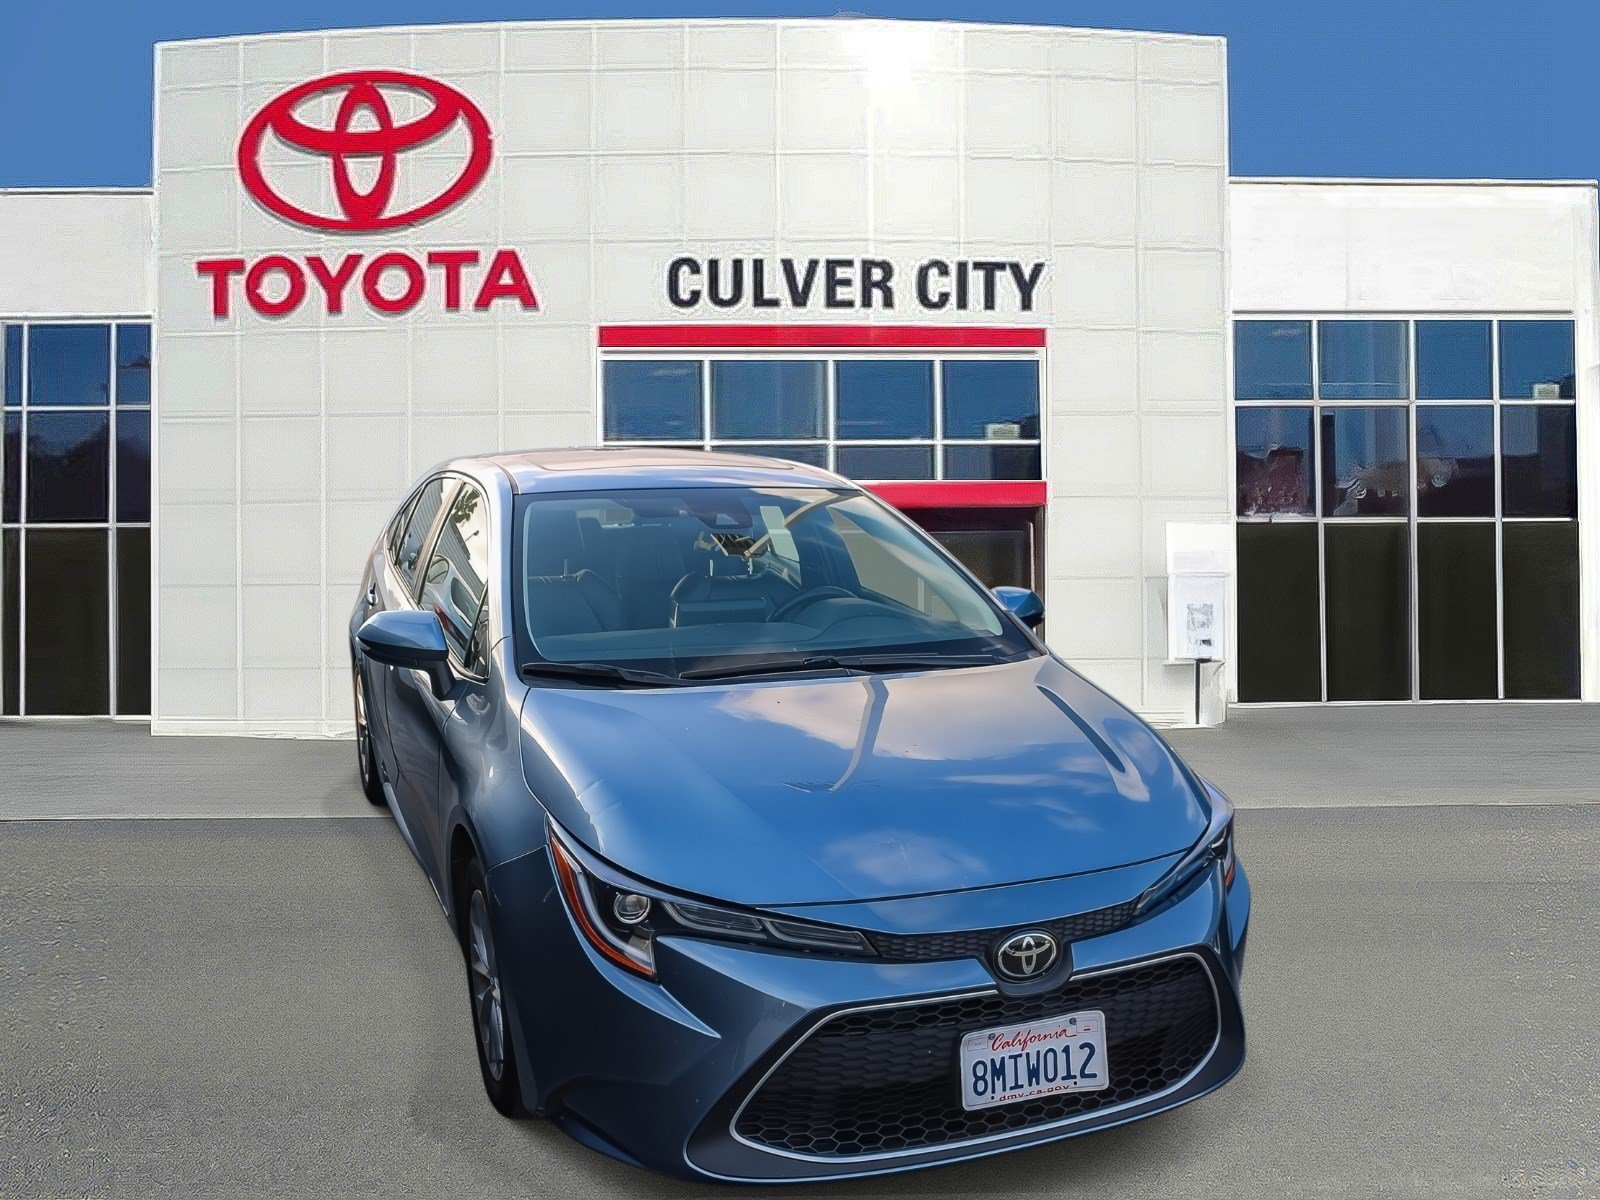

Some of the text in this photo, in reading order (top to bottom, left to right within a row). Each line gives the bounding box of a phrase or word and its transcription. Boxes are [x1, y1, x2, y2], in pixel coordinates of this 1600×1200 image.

[195, 250, 540, 319] TOYOTA
[667, 257, 1045, 311] CULVER CITY
[991, 1026, 1077, 1052] California
[972, 1041, 1098, 1097] 8MIW012
[999, 1084, 1071, 1102] dmv.ca.gov
